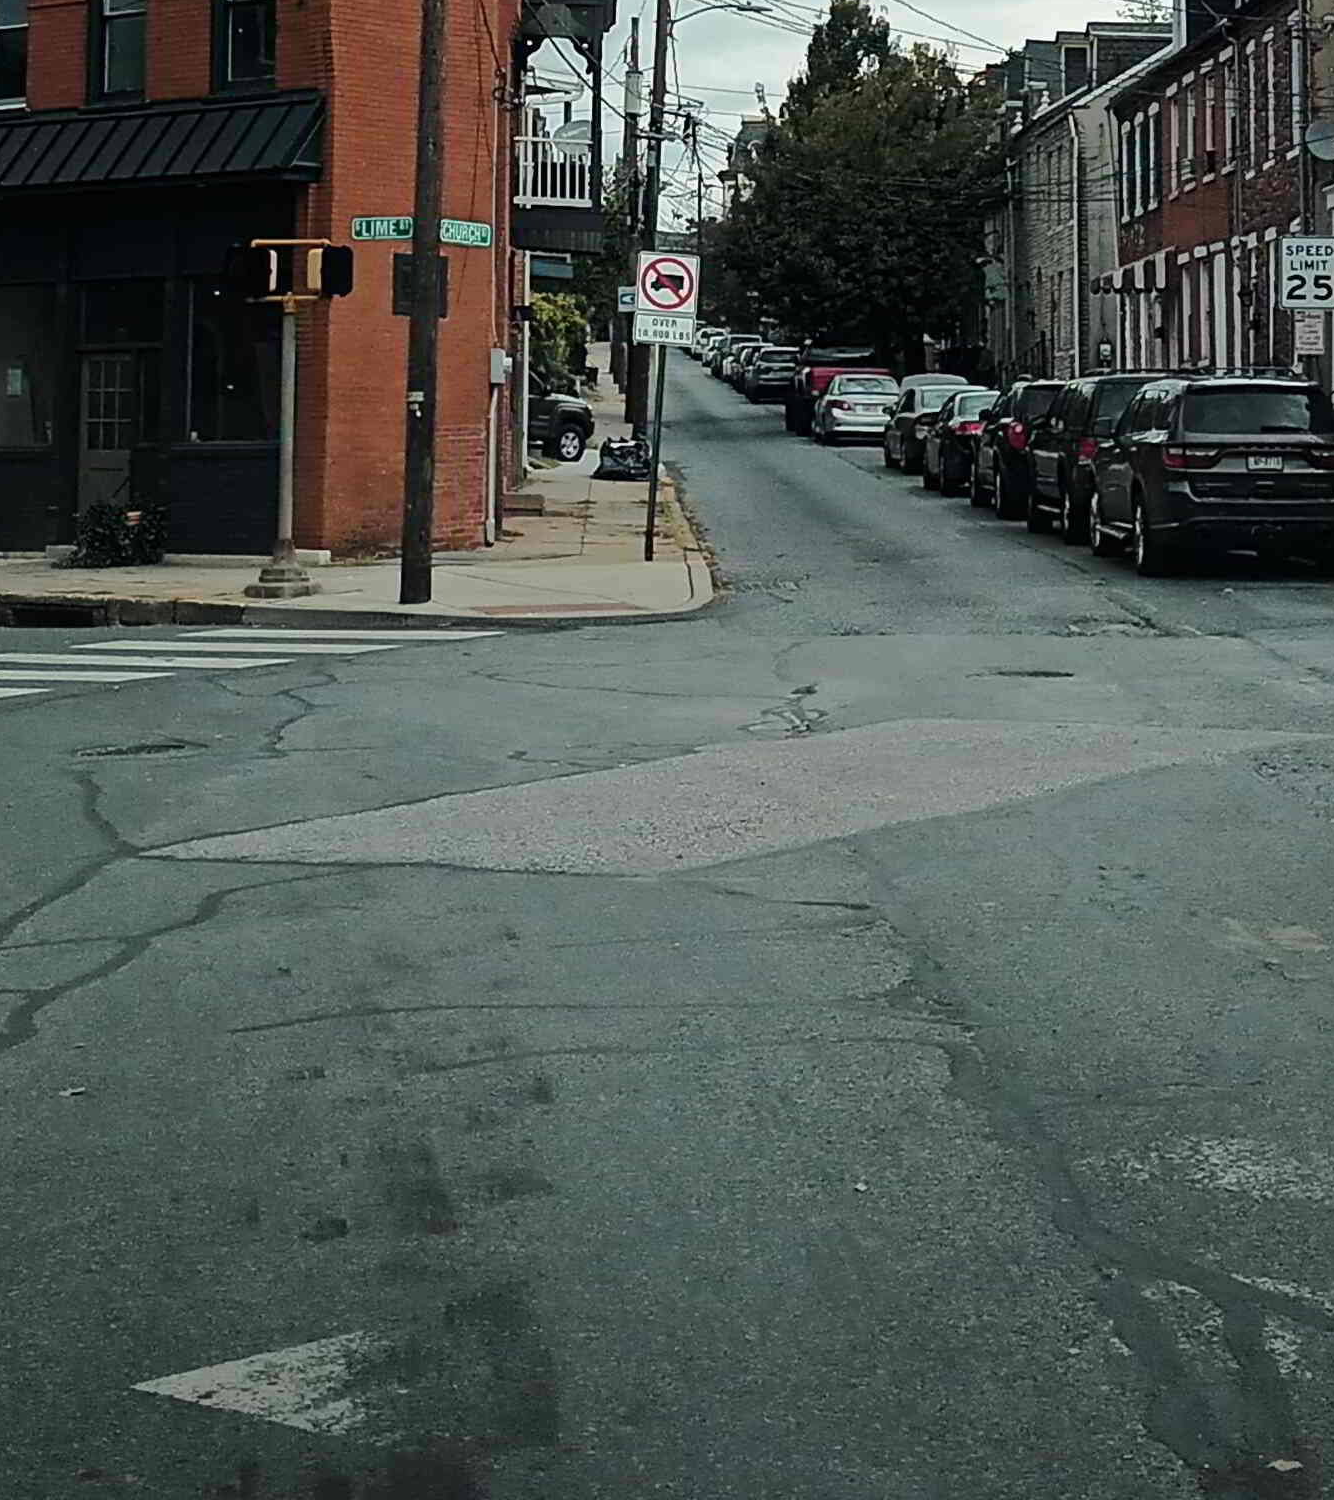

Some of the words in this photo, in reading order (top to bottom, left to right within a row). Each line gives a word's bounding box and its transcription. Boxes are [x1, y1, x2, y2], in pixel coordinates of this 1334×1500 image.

[361, 219, 398, 237] LIME
[442, 221, 481, 242] CHURCH
[1285, 245, 1334, 257] SPEED
[1290, 260, 1329, 271] LIMIT
[1286, 274, 1333, 300] 25
